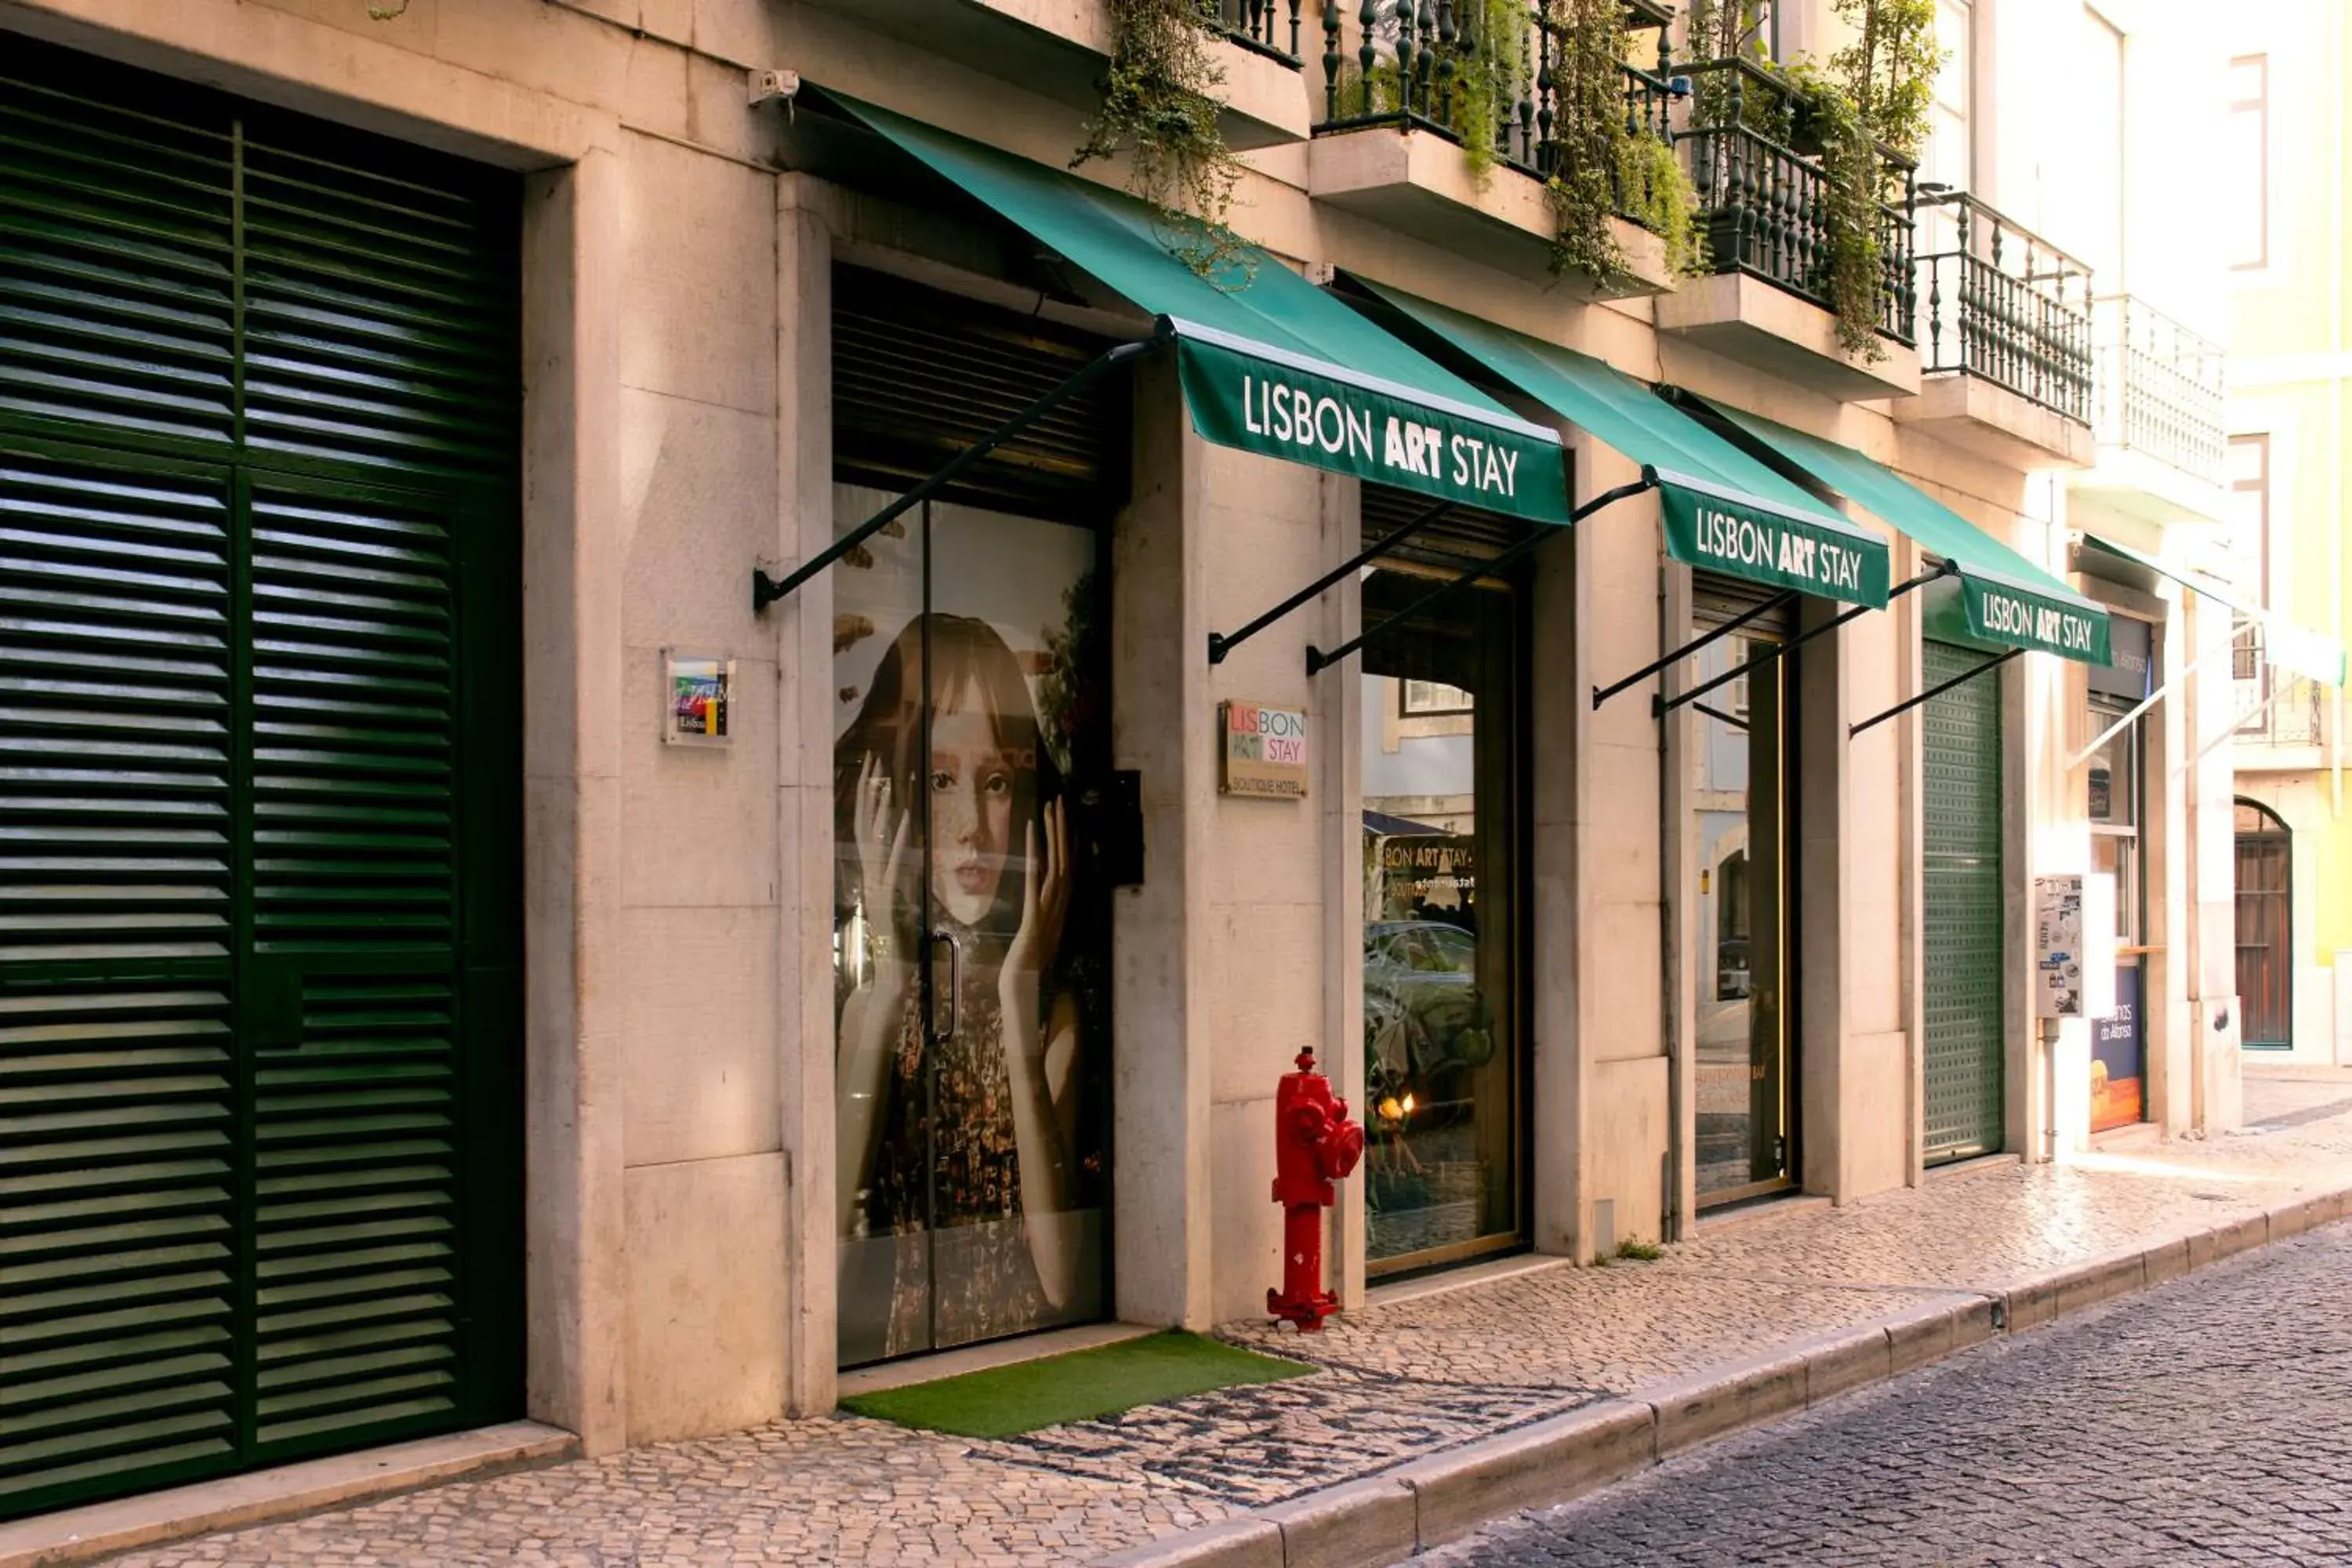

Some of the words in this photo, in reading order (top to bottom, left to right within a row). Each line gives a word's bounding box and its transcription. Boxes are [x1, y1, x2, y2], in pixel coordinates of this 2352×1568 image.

[1243, 376, 1374, 462] LISBON
[1385, 416, 1443, 479] ART
[1451, 434, 1519, 496] STAY
[1697, 507, 1773, 570] LISBON
[1777, 532, 1816, 579] ART
[1820, 542, 1862, 590] STAY
[1983, 593, 2033, 635] LISBON
[2037, 607, 2060, 644] ART
[2063, 614, 2092, 652] STAY
[1231, 706, 1304, 737] LISBON
[1269, 738, 1301, 761] STAY
[1416, 848, 1439, 866] ART
